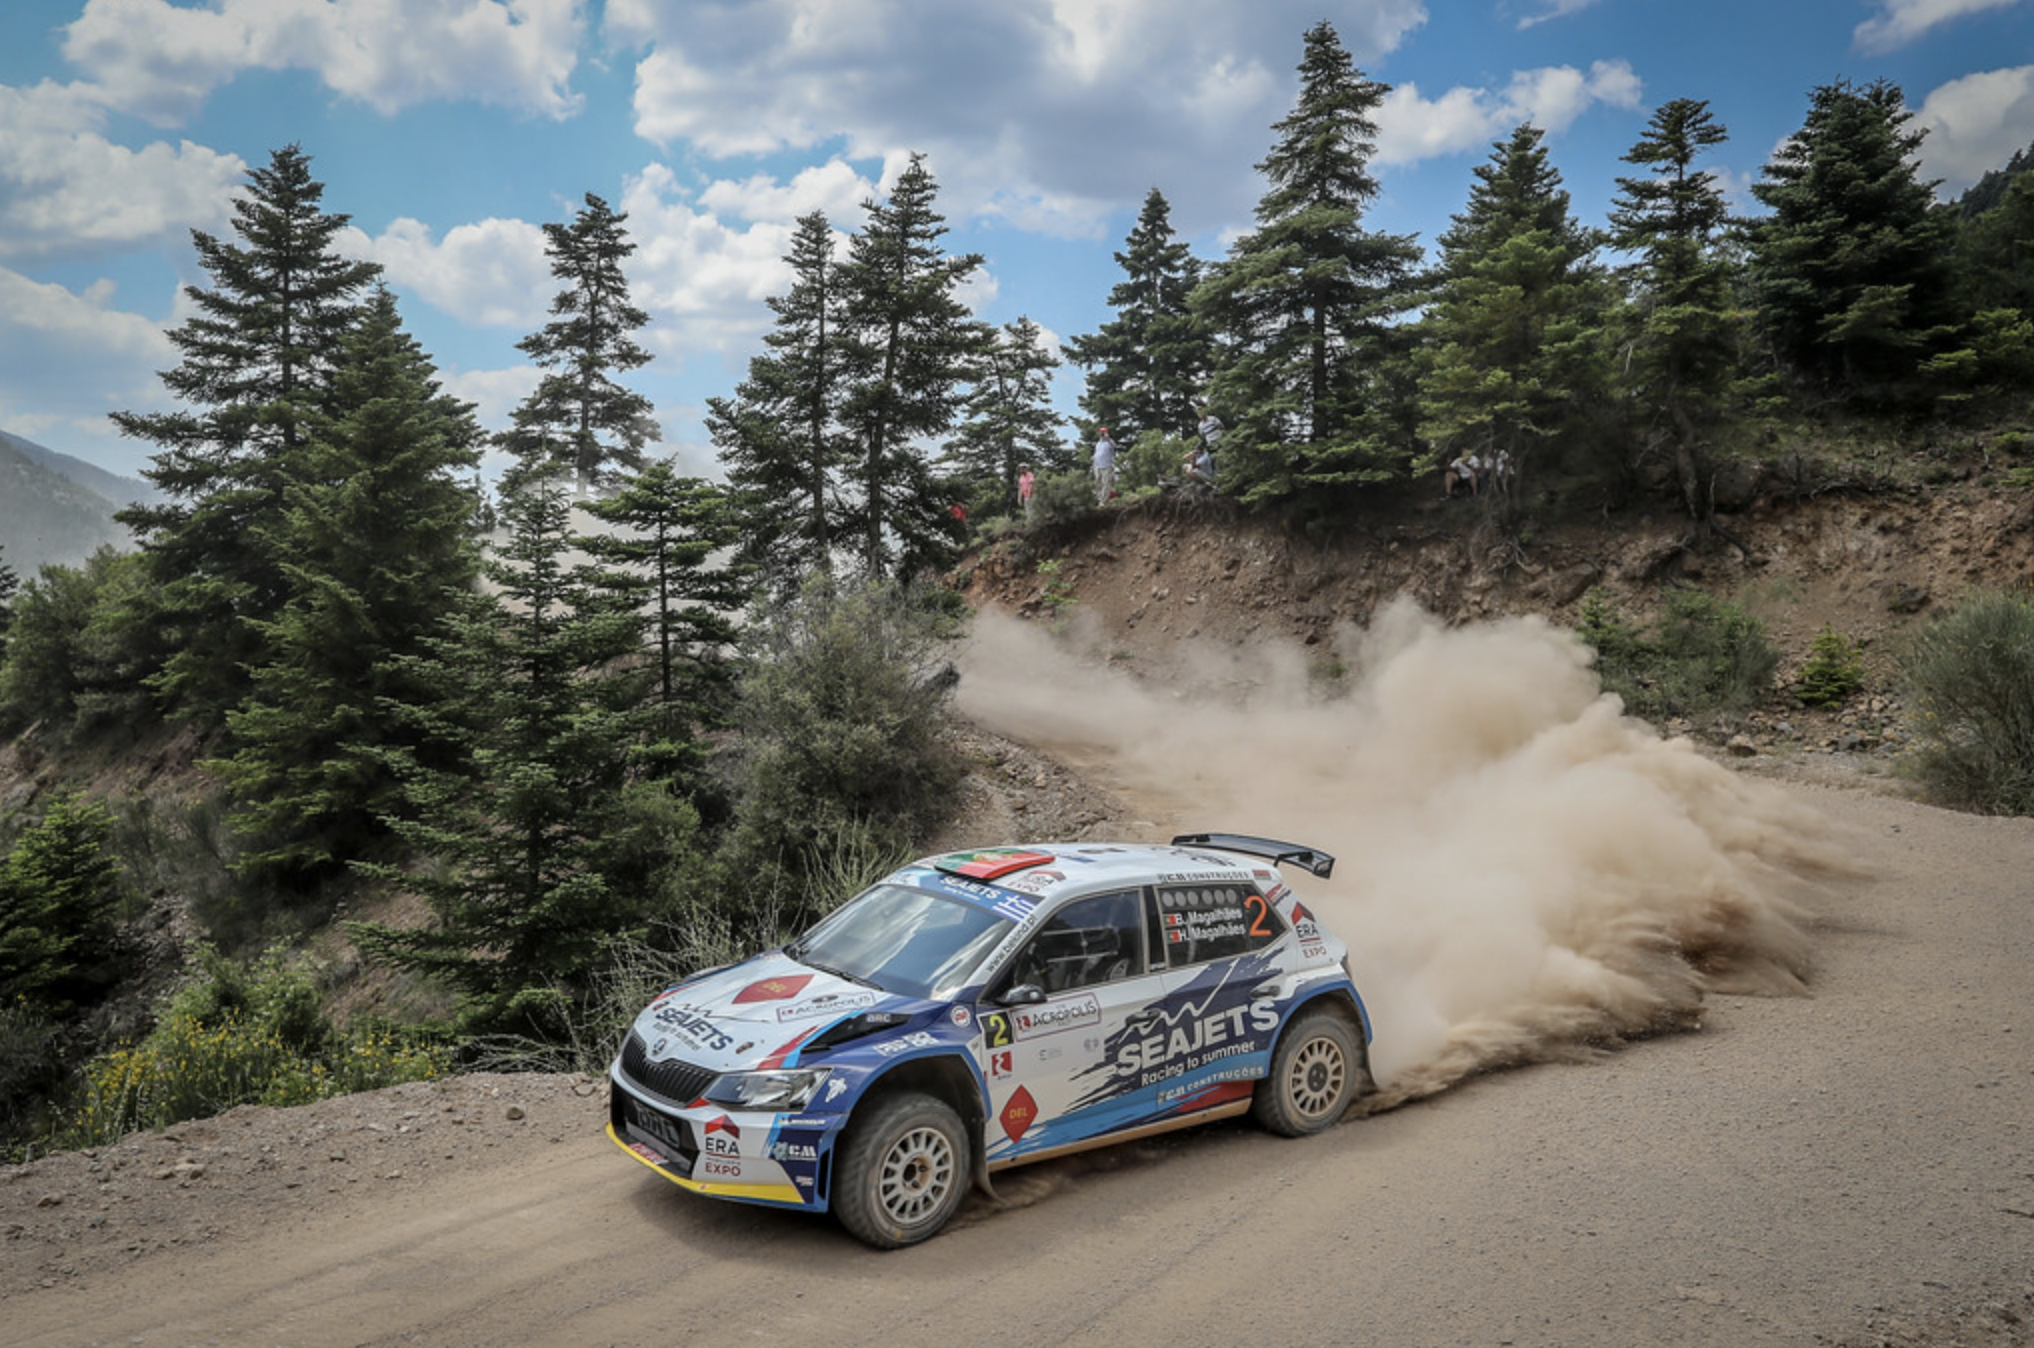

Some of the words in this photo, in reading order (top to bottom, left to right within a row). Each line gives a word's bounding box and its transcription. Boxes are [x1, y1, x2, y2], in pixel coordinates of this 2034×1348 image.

[1188, 908, 1243, 925] Magalhães
[1244, 895, 1271, 936] 2
[1191, 922, 1246, 942] Magalhães
[1296, 924, 1318, 938] ERA
[1033, 1001, 1097, 1027] ACROPOLIS
[655, 1007, 733, 1050] SEAJETS
[989, 1014, 1009, 1047] 2
[1115, 1000, 1280, 1077] SEAJETS
[1141, 1061, 1185, 1088] Racing
[1187, 1055, 1199, 1069] to
[1202, 1040, 1256, 1065] summer
[1187, 1066, 1265, 1091] CONSTRUÇÕES
[705, 1137, 740, 1154] ERA
[705, 1162, 741, 1176] EXPO
